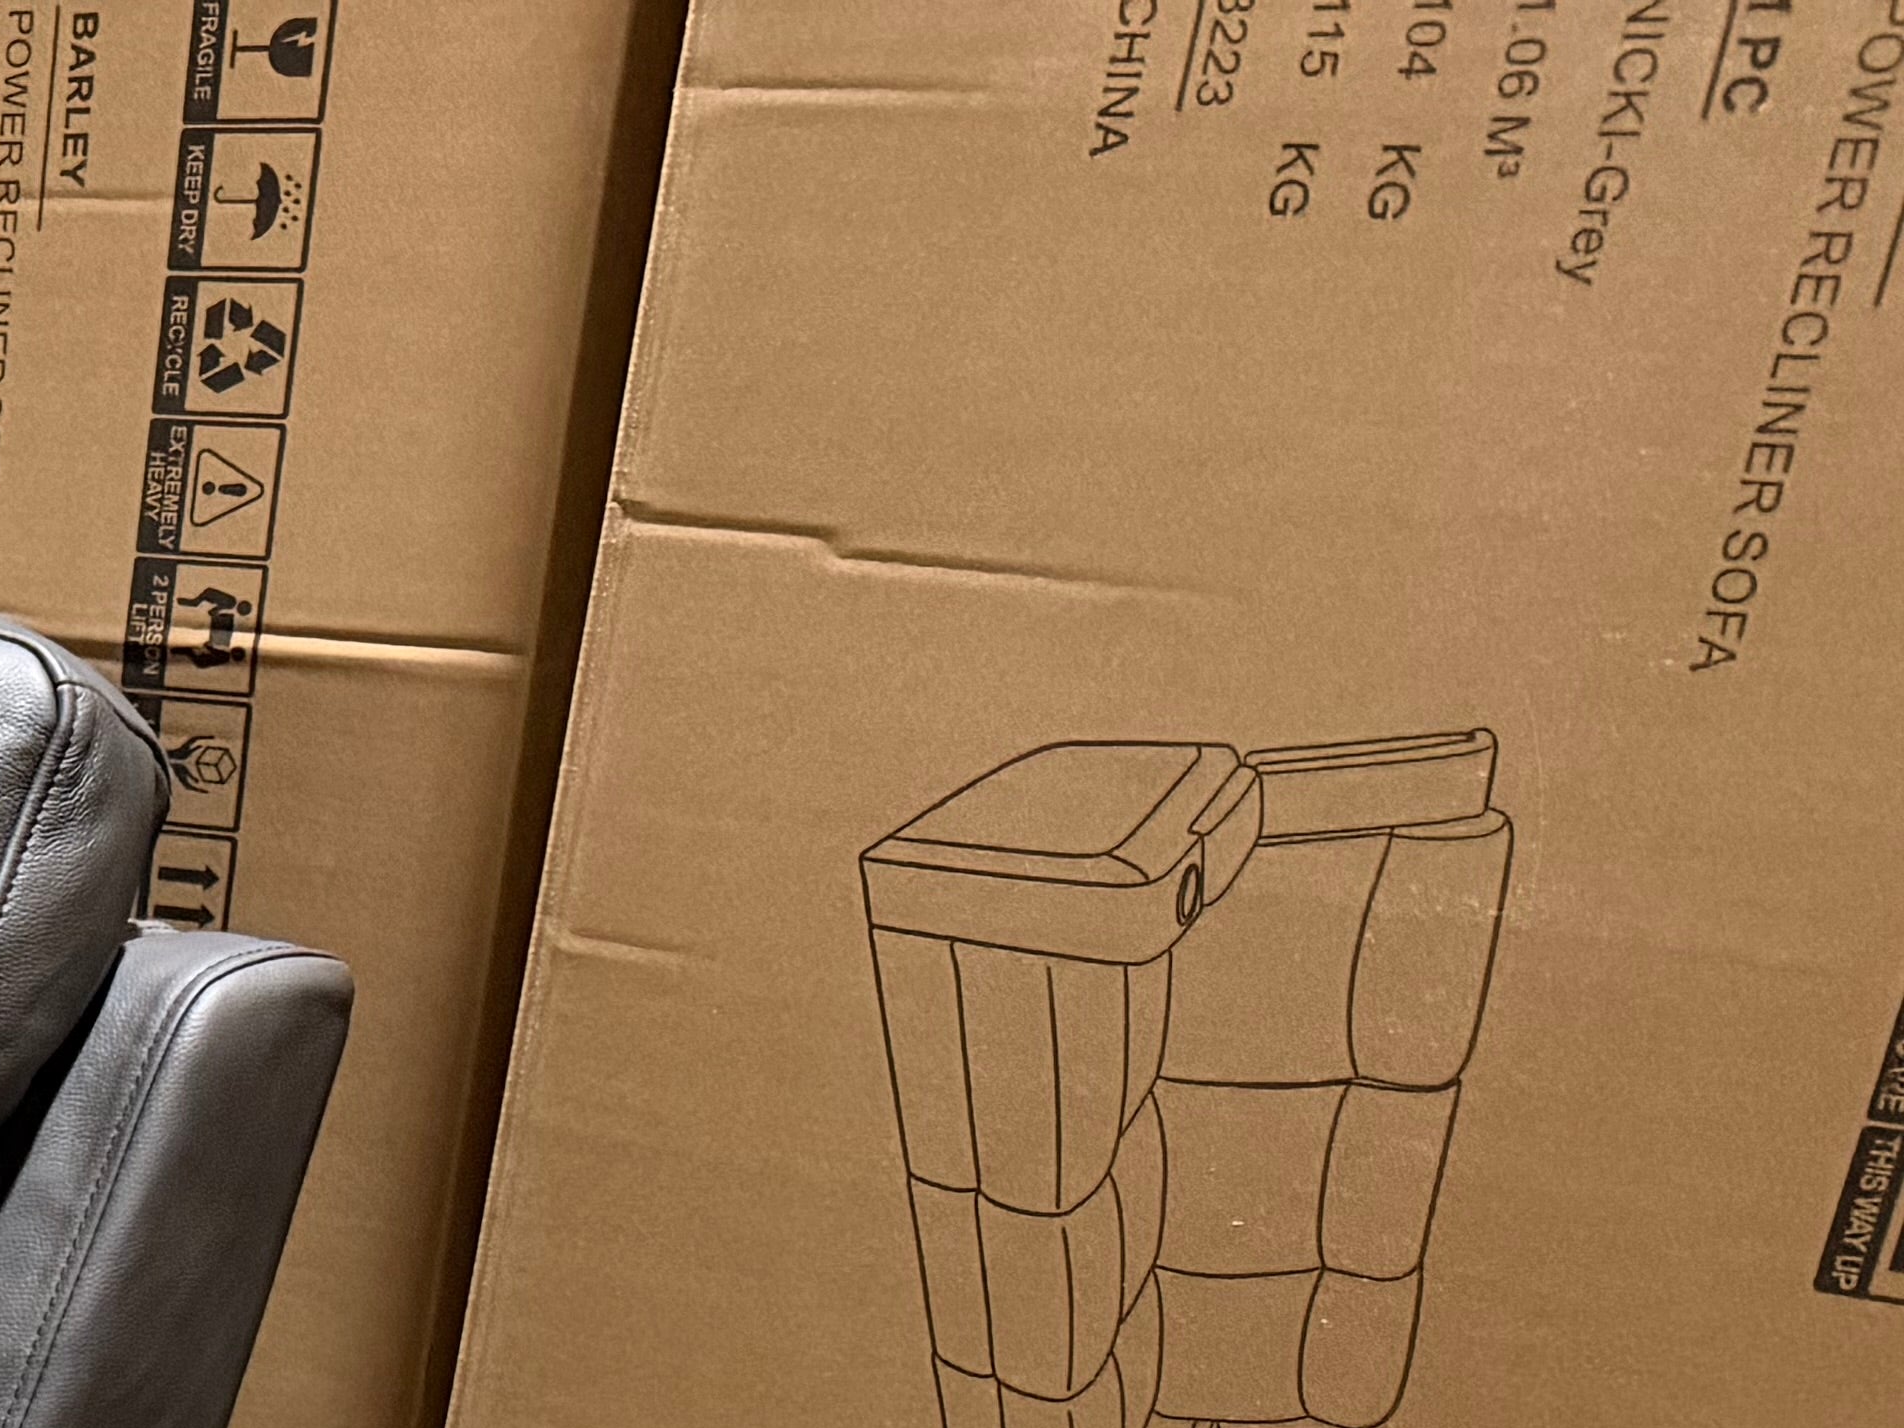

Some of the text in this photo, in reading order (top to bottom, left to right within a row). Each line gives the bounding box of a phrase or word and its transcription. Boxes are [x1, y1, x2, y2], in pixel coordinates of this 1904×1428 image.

[59, 12, 99, 188] BARLEY
[194, 2, 220, 100] FRAGILE
[1089, 0, 1157, 157] CHINA
[1268, 0, 1351, 217] 115 KG
[1367, 0, 1454, 220] 104 KG
[1722, 36, 1783, 115] PC
[178, 144, 206, 253] KEEP DRY
[1732, 230, 1854, 514] RECLINER
[145, 451, 167, 523] HEAVY
[158, 425, 188, 551] EXTREMELY
[127, 603, 147, 643] LIFT
[141, 590, 169, 676] PERSON
[152, 575, 170, 588] 2
[1688, 529, 1769, 672] SOFA
[1831, 1136, 1902, 1291] THIS WAY UP
